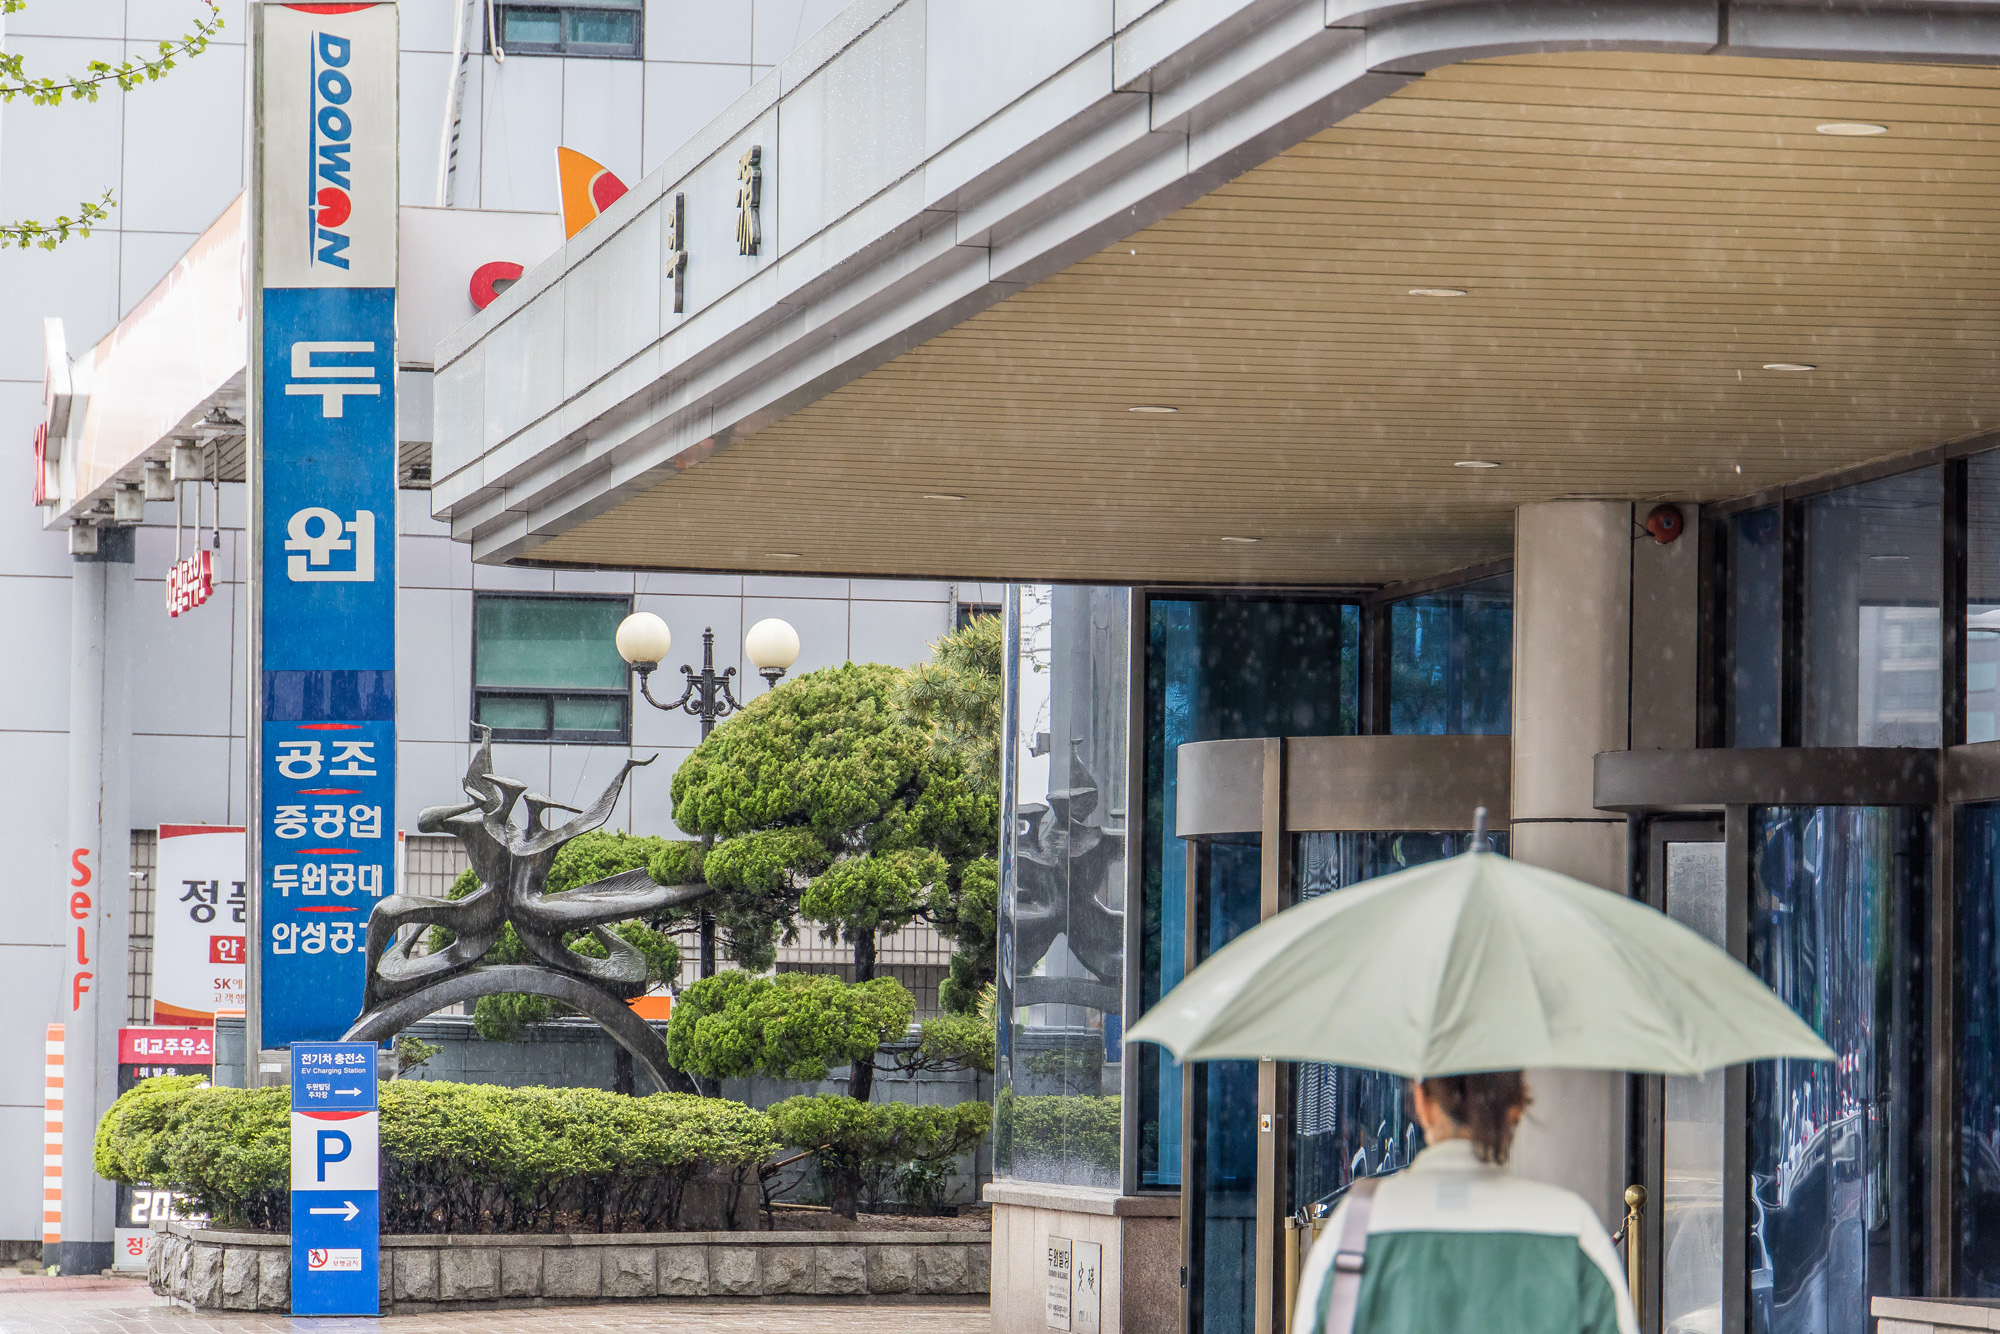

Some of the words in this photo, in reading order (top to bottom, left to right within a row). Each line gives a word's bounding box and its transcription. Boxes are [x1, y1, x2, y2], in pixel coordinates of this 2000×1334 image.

[317, 32, 352, 270] DOOWON
[275, 741, 377, 779] 공조
[273, 804, 382, 839] 중공업
[272, 863, 383, 897] 두원공대
[71, 848, 93, 1011] Self
[217, 939, 246, 961] 안
[133, 1037, 211, 1056] 대교주유소
[301, 1053, 332, 1064] 전기차
[334, 1053, 366, 1064] 충전소
[313, 1067, 341, 1075] Charging
[306, 1083, 331, 1091] 두원빌딩
[308, 1091, 328, 1099] 주차장
[317, 1130, 352, 1182] P
[126, 1237, 151, 1256] 정
